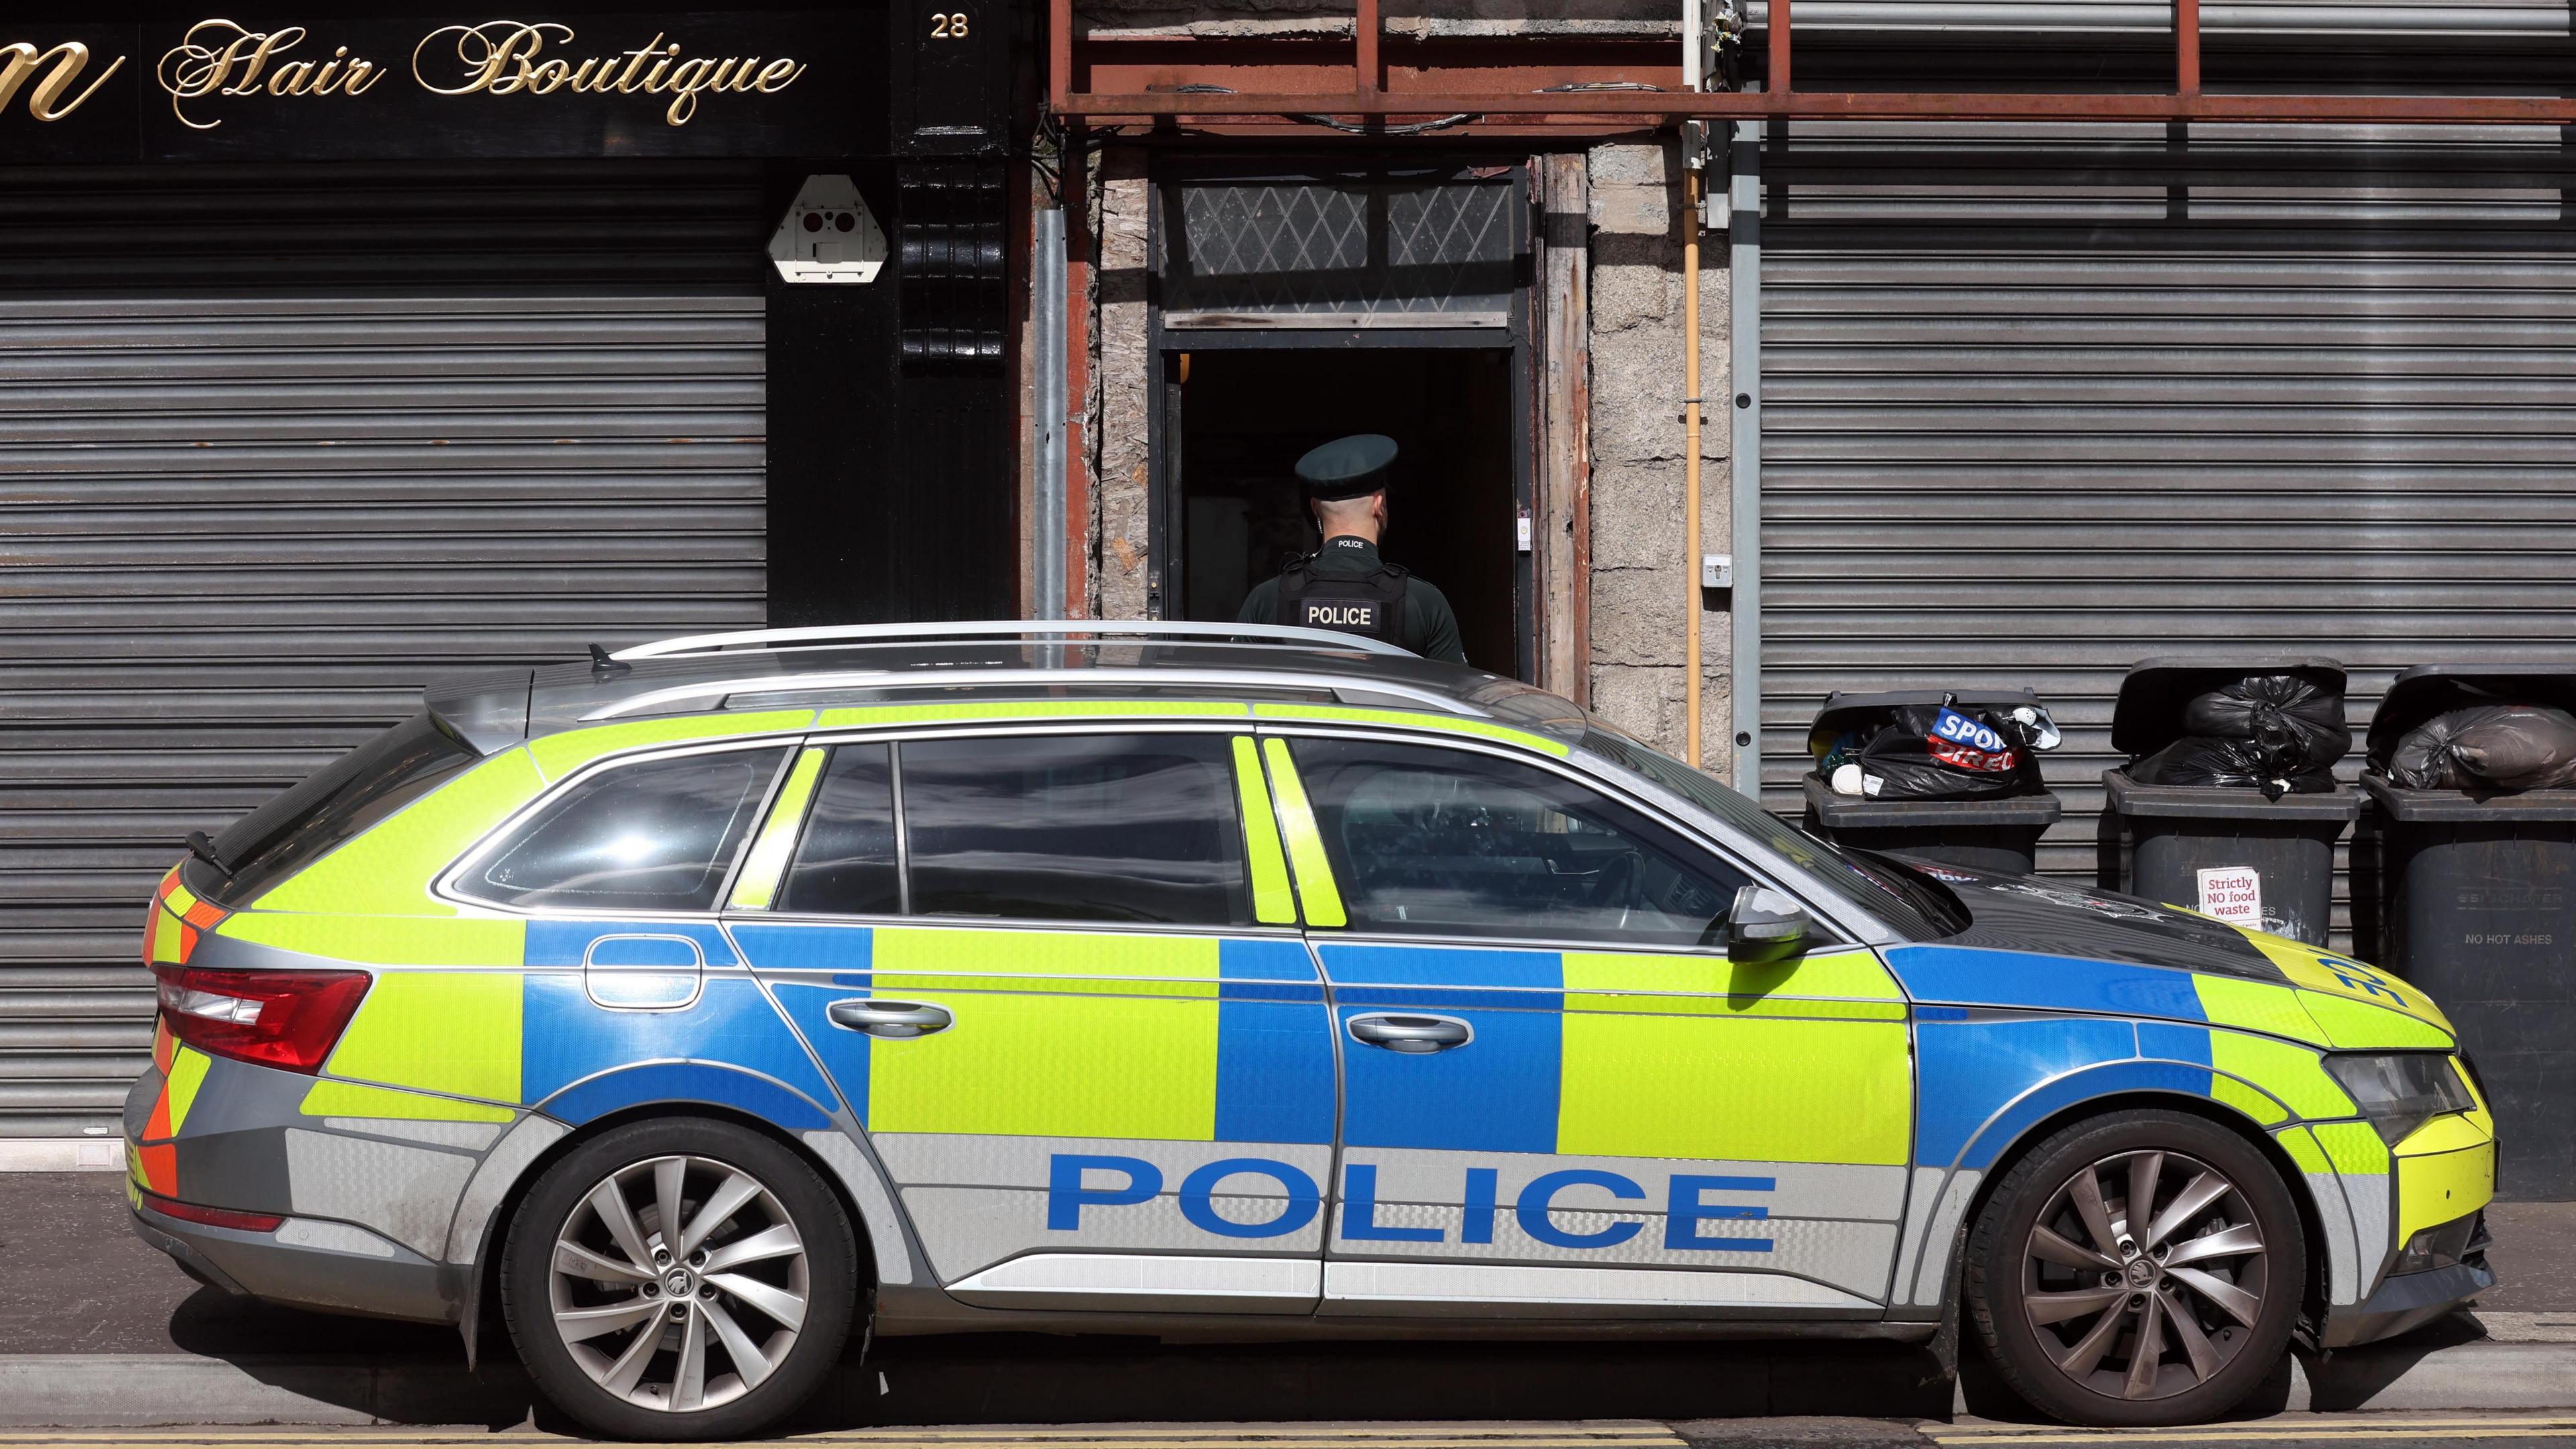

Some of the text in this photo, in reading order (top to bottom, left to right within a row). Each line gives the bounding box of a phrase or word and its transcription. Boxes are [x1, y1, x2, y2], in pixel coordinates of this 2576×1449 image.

[930, 13, 969, 38] 28
[157, 18, 387, 129] Hair
[412, 19, 807, 126] Boutique
[1338, 540, 1364, 548] POLICE
[1308, 606, 1371, 625] POLICE
[1935, 742, 2015, 771] DIREC
[2208, 877, 2253, 890] Strictly
[2207, 890, 2255, 904] NO food
[2214, 905, 2250, 916] waste
[2465, 934, 2553, 945] NO HOT ASHES
[1046, 1154, 1776, 1252] POLICE
